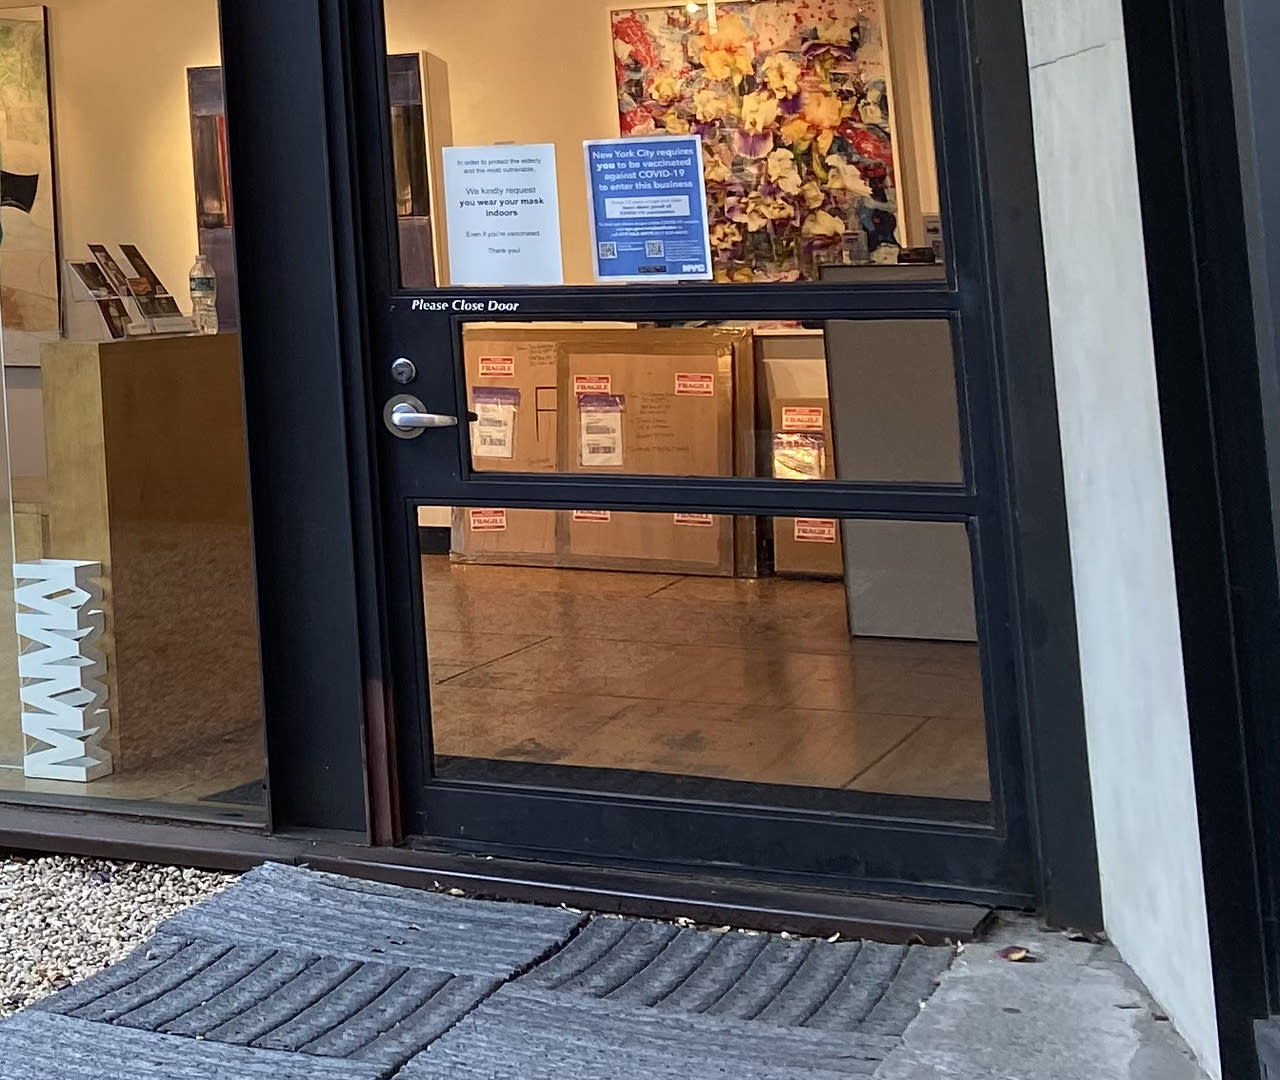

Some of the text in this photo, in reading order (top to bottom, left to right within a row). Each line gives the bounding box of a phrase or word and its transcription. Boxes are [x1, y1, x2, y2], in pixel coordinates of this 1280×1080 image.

[592, 148, 694, 159] New York City requires
[596, 162, 615, 171] you
[629, 160, 640, 168] be
[642, 158, 691, 168] vaccinated
[604, 169, 685, 181] against COVID-19
[505, 187, 536, 195] request
[599, 183, 608, 191] to
[635, 182, 652, 190] this
[653, 180, 693, 189] business
[459, 200, 475, 208] you
[499, 199, 518, 207] your
[520, 197, 544, 205] mask
[411, 298, 519, 311] Please Close Door
